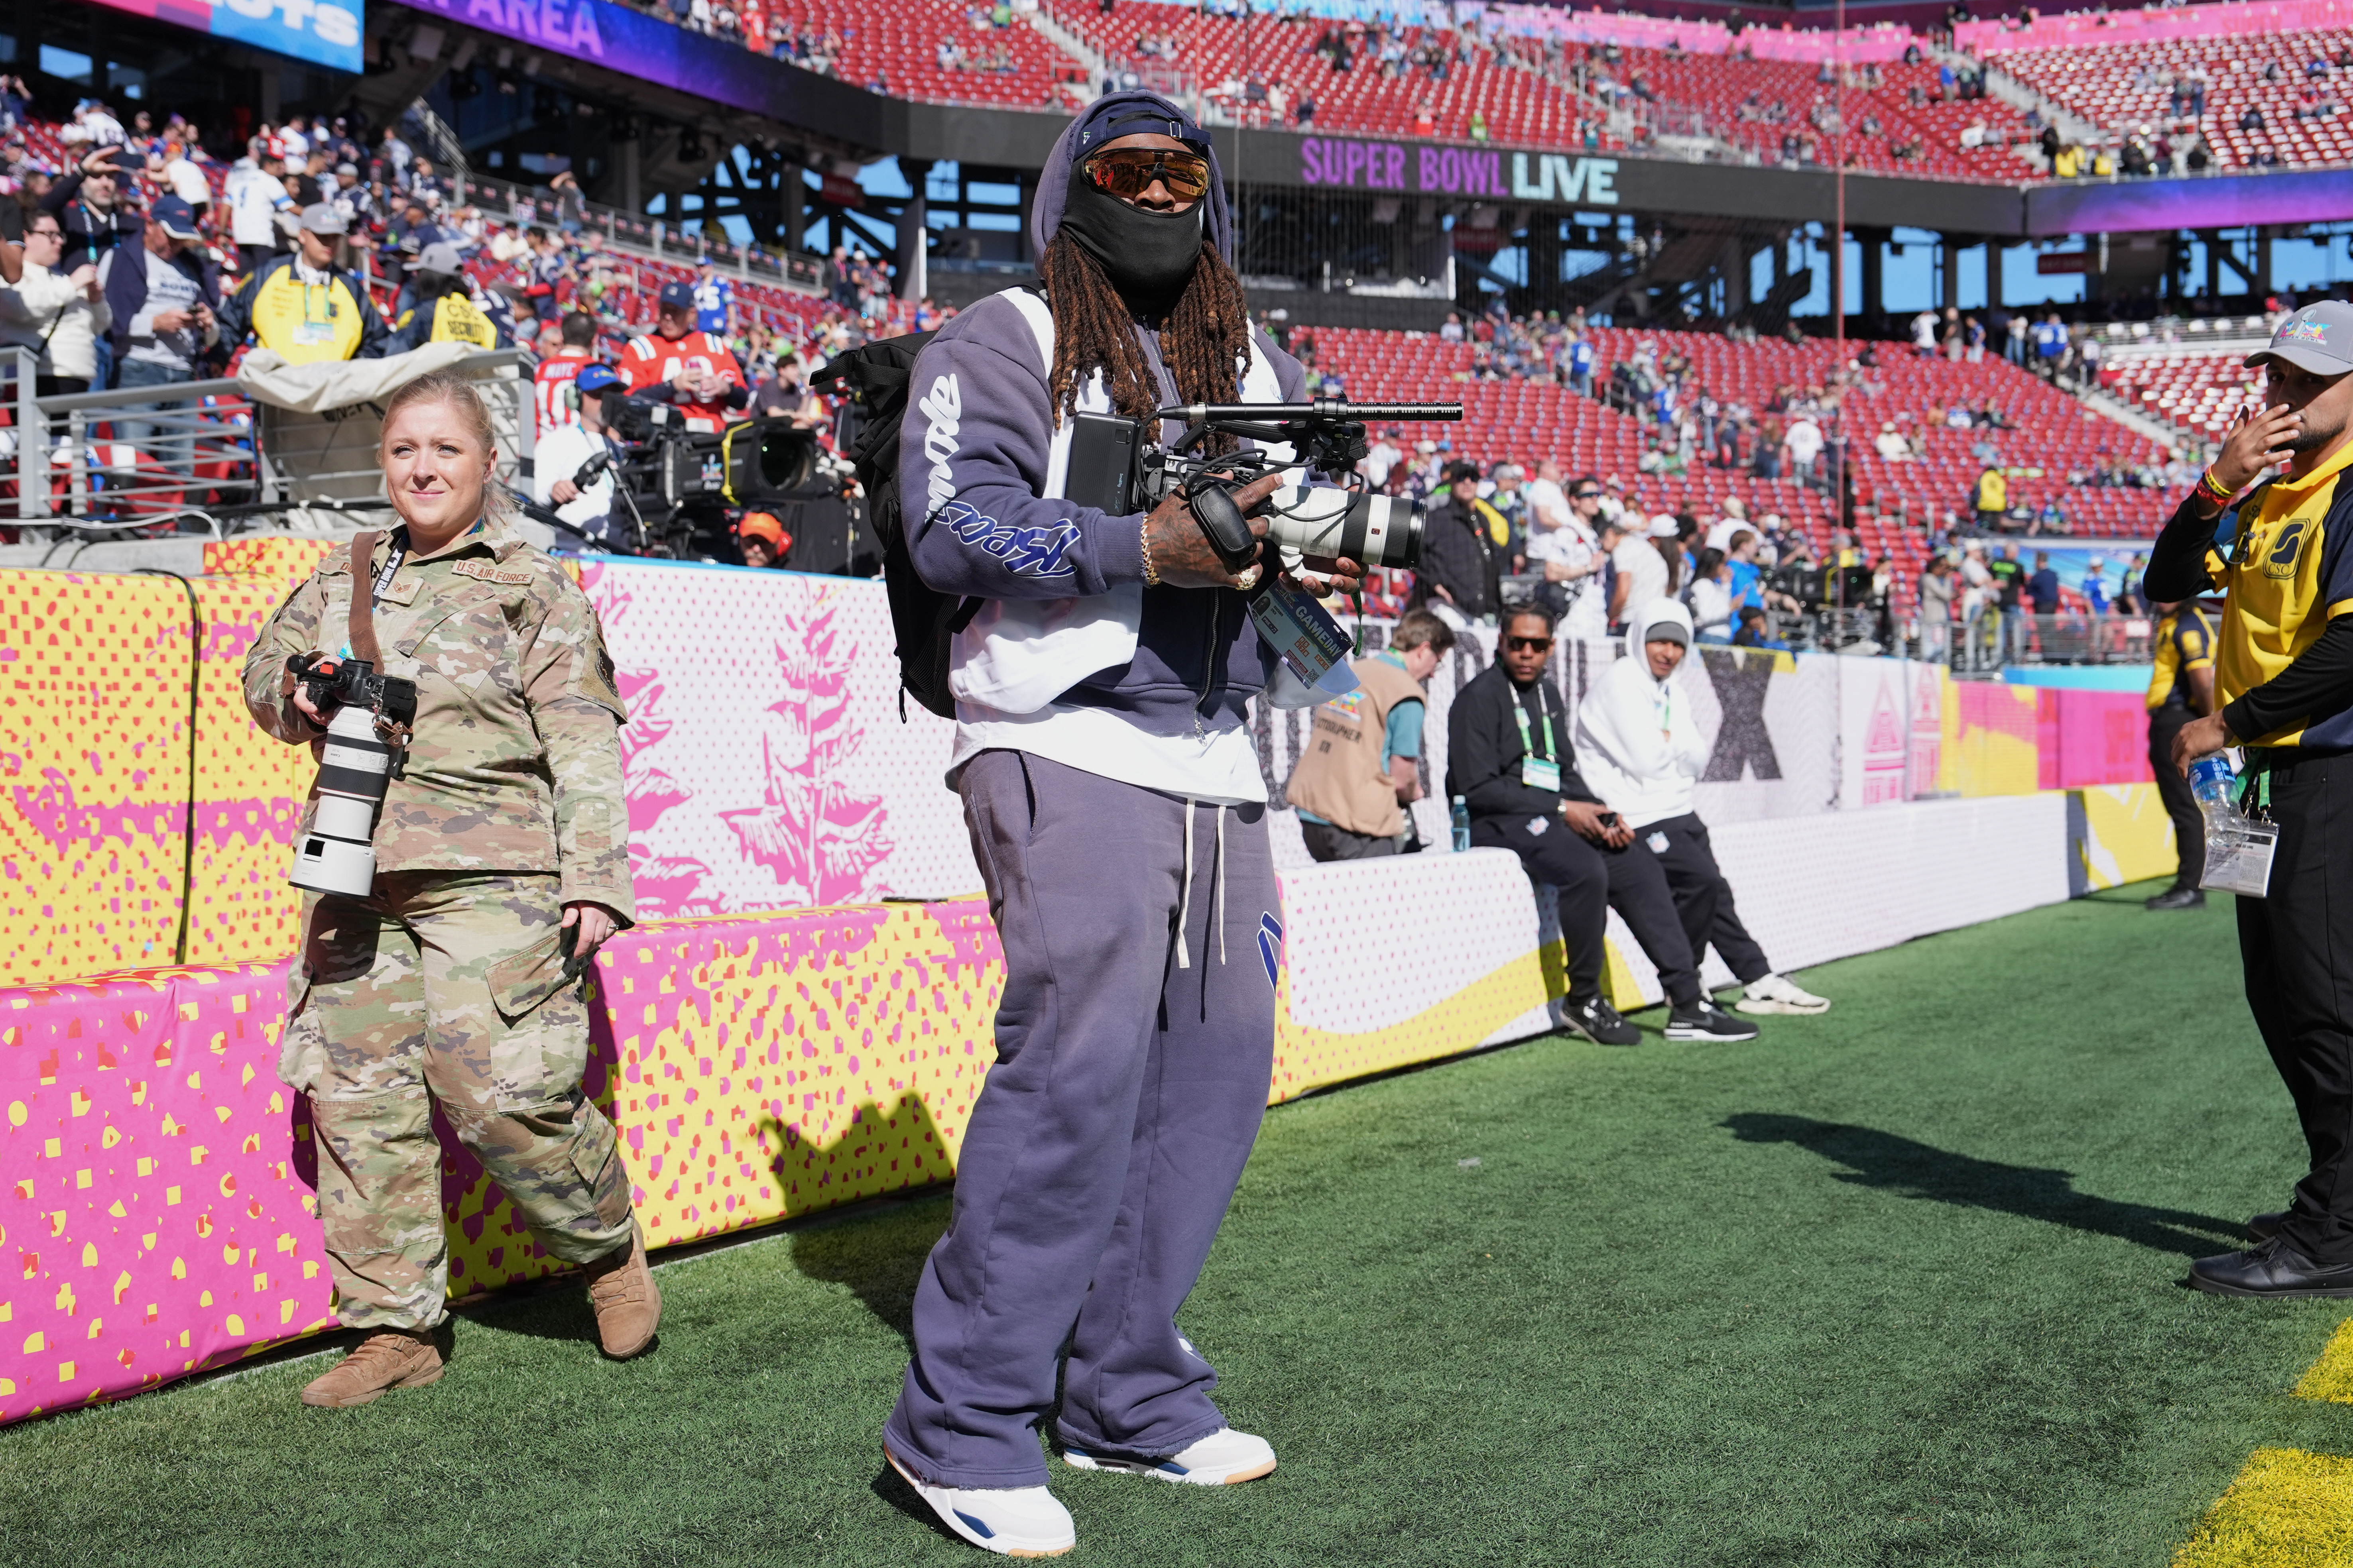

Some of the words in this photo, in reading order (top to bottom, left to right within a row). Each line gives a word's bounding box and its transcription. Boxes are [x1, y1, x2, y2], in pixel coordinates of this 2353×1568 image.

[1301, 137, 1406, 189] SUPER
[1418, 146, 1508, 196] BOWL
[1512, 152, 1619, 204] LIVE
[926, 500, 1081, 578] Beas
[387, 548, 403, 569] LX
[2268, 563, 2290, 575] CSC
[380, 567, 395, 582] BOWL
[456, 561, 476, 575] U.S.
[477, 568, 495, 578] AIR
[495, 571, 531, 582] FORCE
[373, 580, 388, 597] SUPER
[1263, 617, 1271, 626] PRE
[1294, 605, 1343, 658] GAMEDAY
